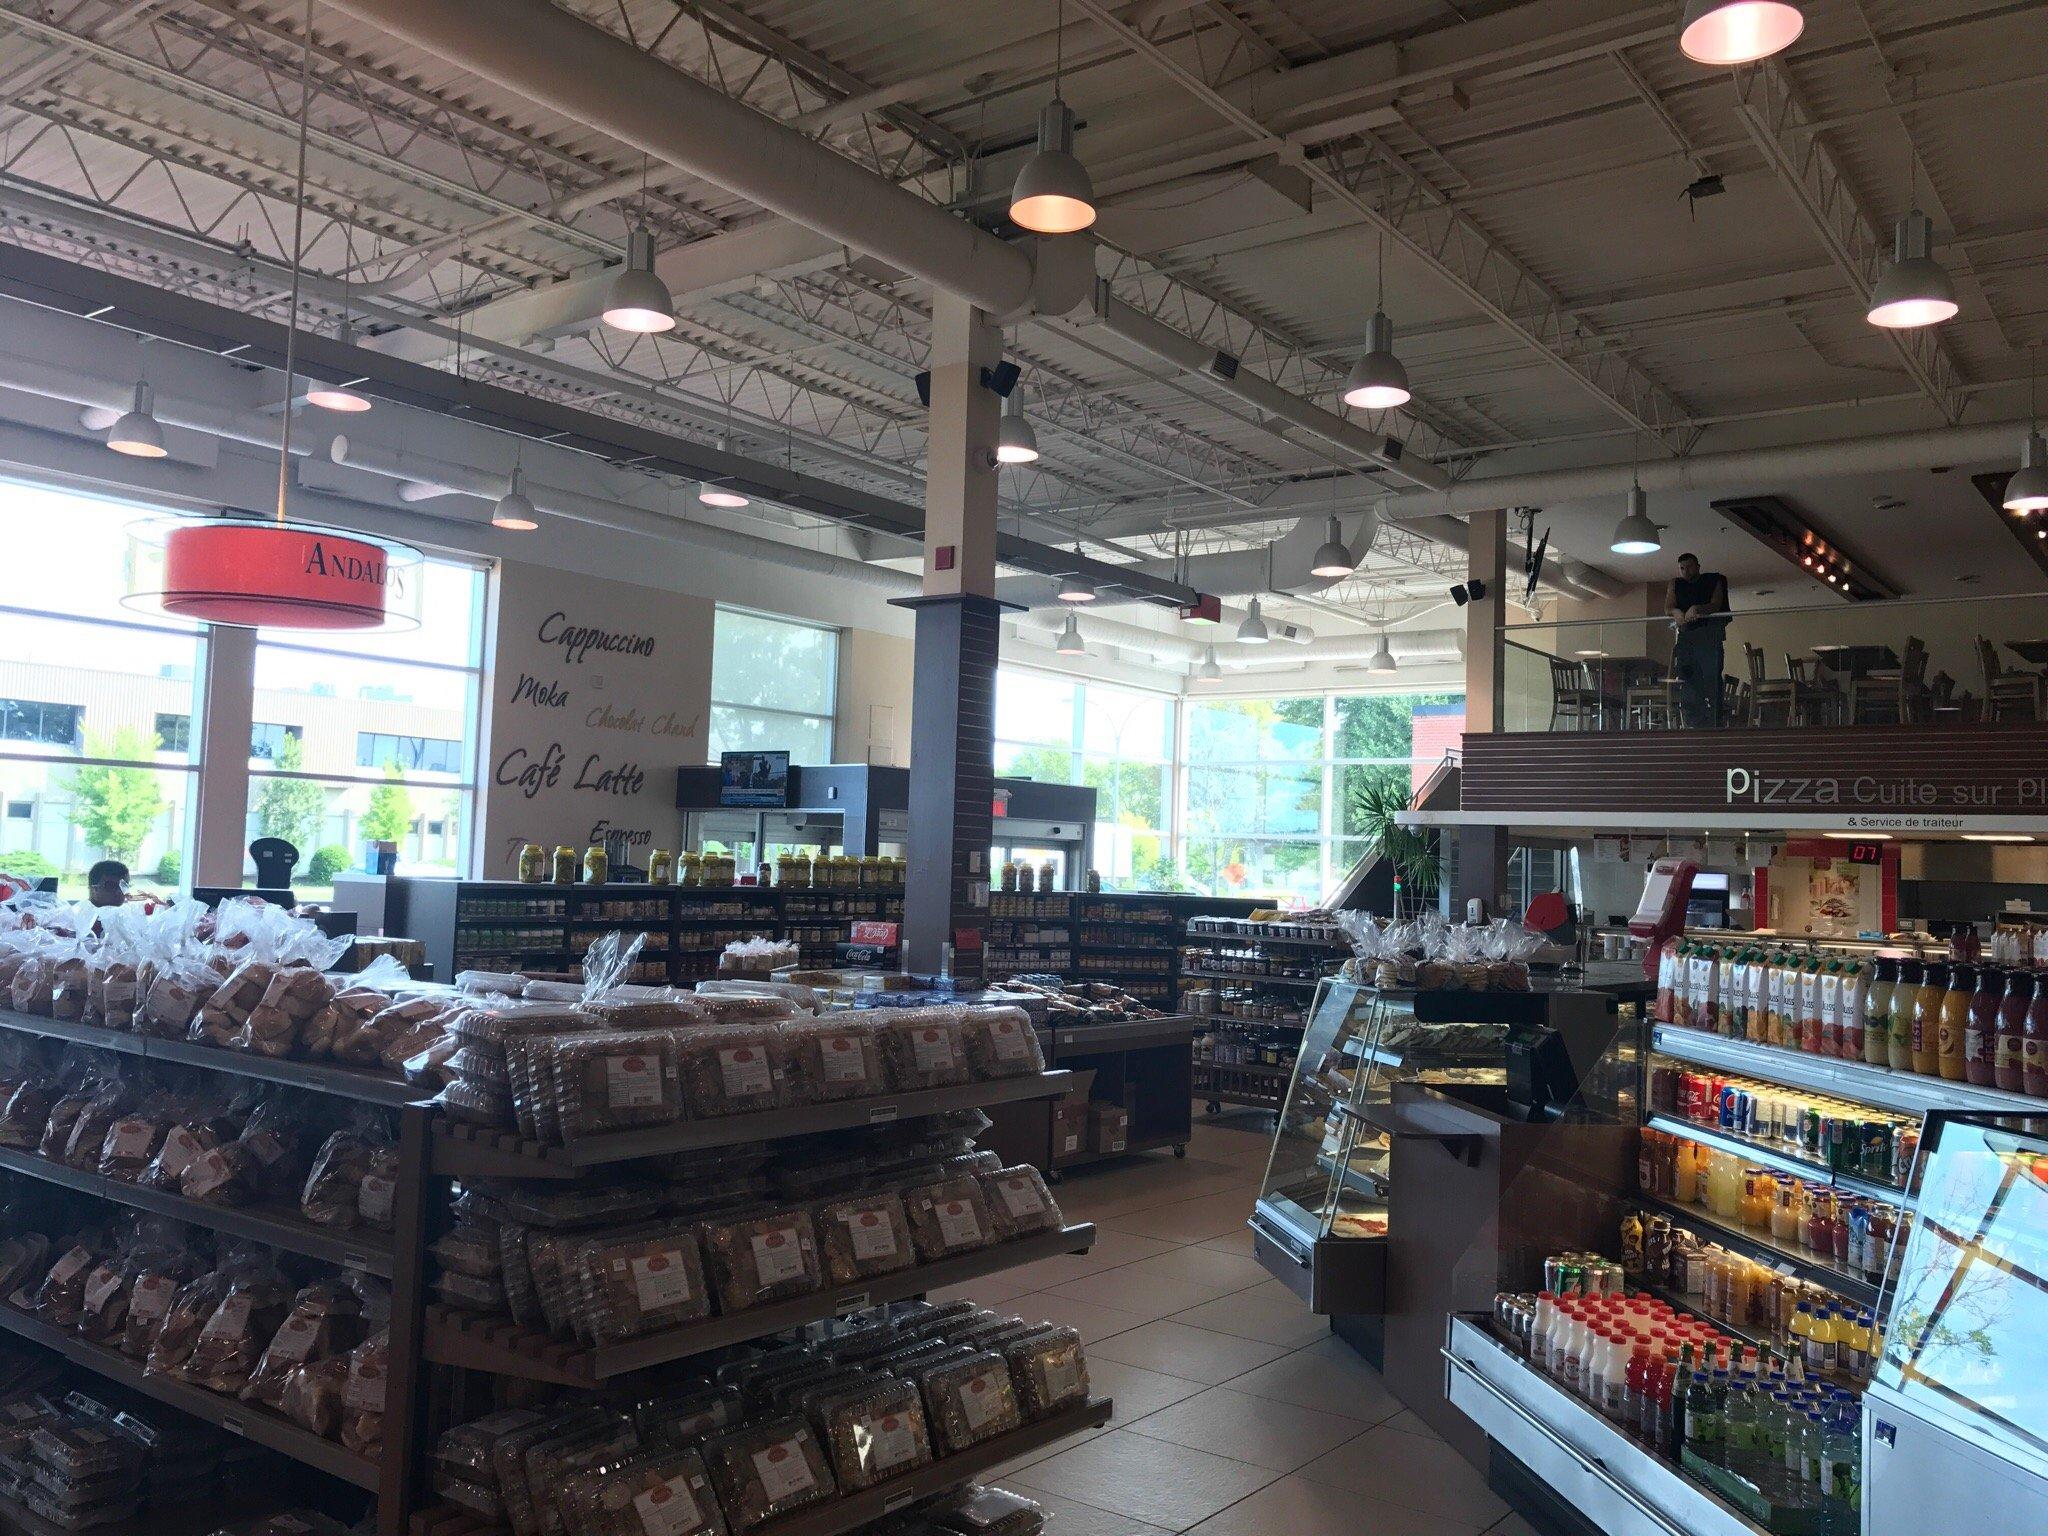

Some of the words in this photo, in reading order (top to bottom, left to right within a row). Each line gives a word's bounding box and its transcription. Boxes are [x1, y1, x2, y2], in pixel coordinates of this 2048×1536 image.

[538, 611, 655, 664] Cappuccino
[511, 673, 570, 708] Moka
[496, 742, 566, 799] Café
[573, 754, 644, 796] Latte
[1853, 776, 1938, 805] Cuite
[1952, 783, 2002, 805] sur
[1847, 817, 1857, 827] &
[1860, 817, 1902, 827] Service
[1905, 817, 1919, 827] de
[1923, 817, 1964, 827] traiteur
[1853, 846, 1877, 860] 07
